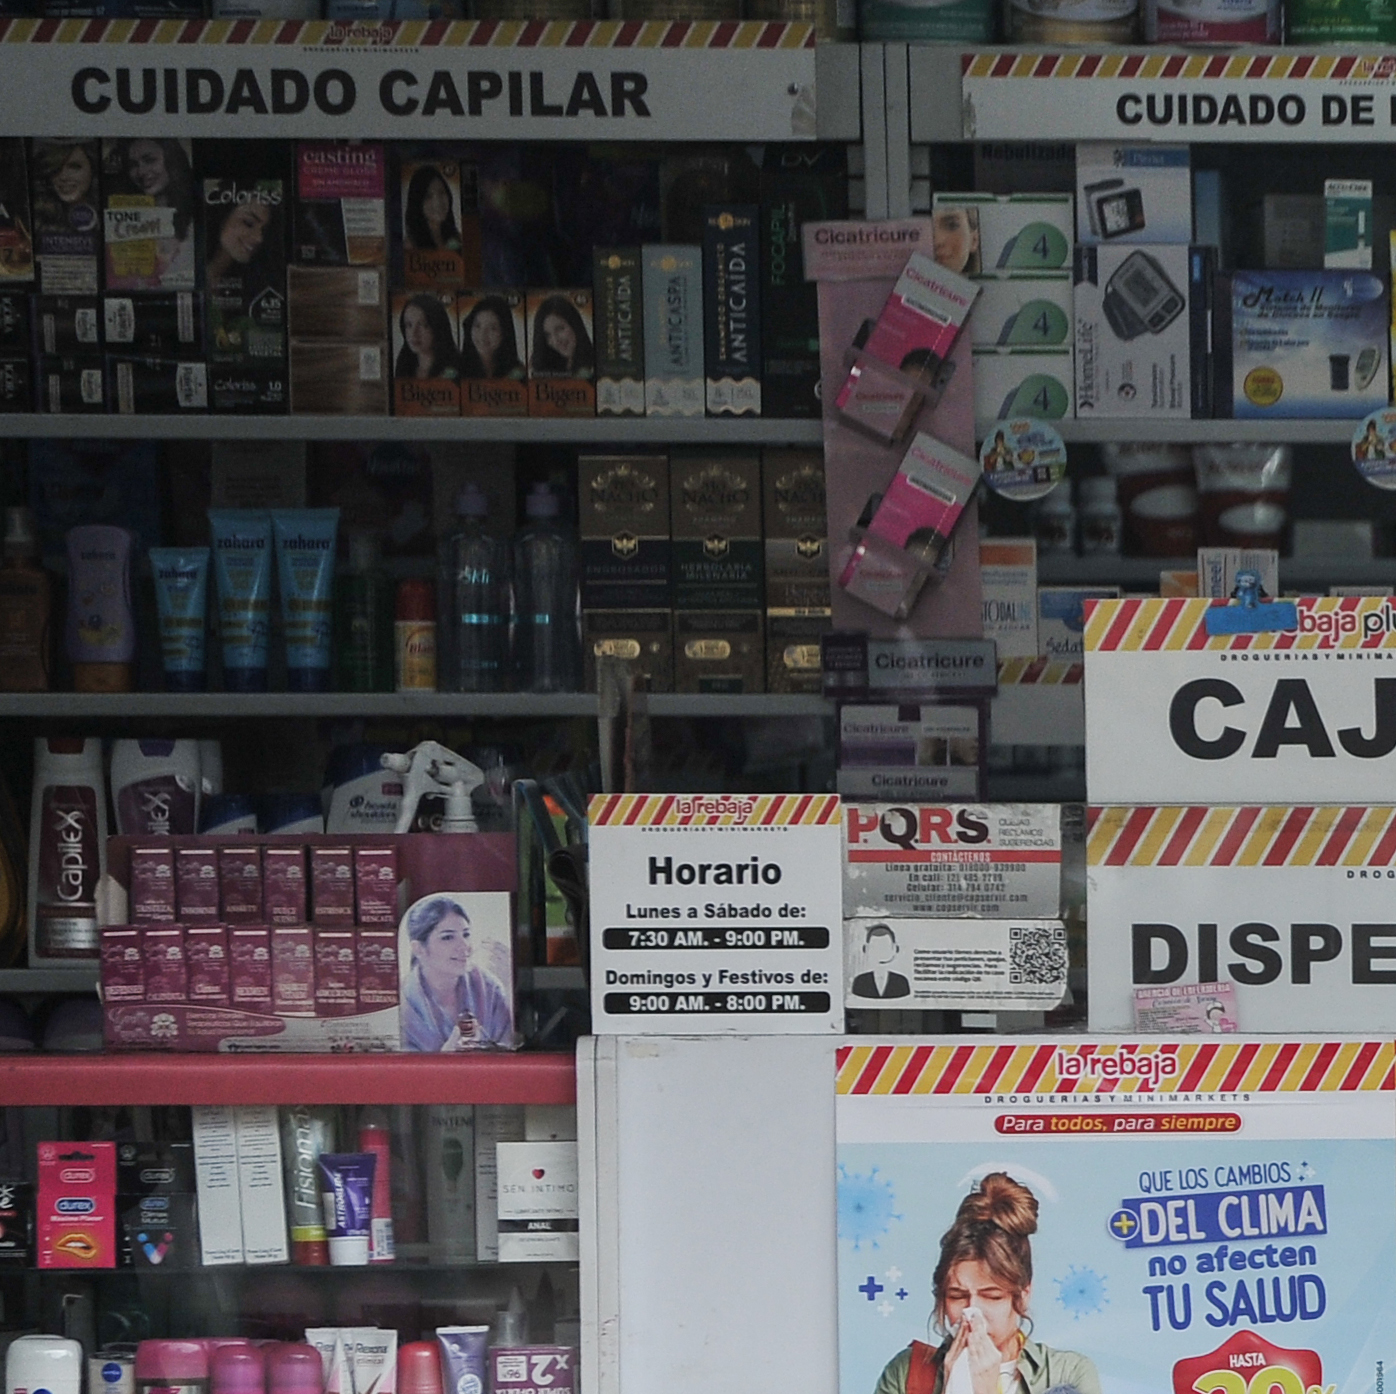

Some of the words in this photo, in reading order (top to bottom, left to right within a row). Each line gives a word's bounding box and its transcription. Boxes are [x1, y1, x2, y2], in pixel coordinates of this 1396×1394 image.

[70, 66, 358, 117] CUIDADO
[378, 69, 652, 119] CAPILAR
[1116, 93, 1306, 126] CUIDADO
[1321, 94, 1375, 126] DE
[303, 150, 376, 167] casting
[205, 182, 282, 205] Coloriss
[814, 227, 919, 245] Cicatricure
[876, 653, 984, 669] Cicatricure
[847, 807, 991, 850] P.Q.R.S.
[931, 851, 991, 862] CONTÁCTENOS
[648, 856, 782, 885] Horario
[626, 904, 681, 918] Lunes
[687, 907, 697, 918] a
[704, 903, 772, 918] Sábado
[778, 903, 806, 918] de:
[629, 931, 668, 946] 7:30
[673, 931, 709, 946] AM.
[725, 931, 765, 946] 9:00
[771, 930, 804, 945] PM.
[605, 970, 696, 988] Domingos
[702, 973, 712, 988] y
[718, 969, 794, 984] Festivos
[800, 969, 828, 984] de:
[629, 995, 669, 1011] 9:00
[674, 995, 710, 1010] AM.
[726, 995, 766, 1010] 8:00
[772, 994, 806, 1009] PM.
[1002, 1116, 1044, 1132] Para
[1049, 1115, 1108, 1133] todos,
[1114, 1117, 1156, 1133] para
[1161, 1114, 1236, 1133] siempre
[1139, 1169, 1173, 1194] QUE
[1179, 1167, 1210, 1191] LOS
[1214, 1162, 1291, 1189] CAMBIOS
[503, 1184, 530, 1194] SEN
[56, 1198, 94, 1212] durex
[1140, 1199, 1206, 1243] DEL
[1217, 1191, 1325, 1239] CLIMA
[1149, 1254, 1188, 1277] no
[1196, 1245, 1317, 1274] afecten
[1143, 1283, 1192, 1331] TU
[1204, 1274, 1326, 1328] SALUD
[1229, 1353, 1266, 1368] HASTA
